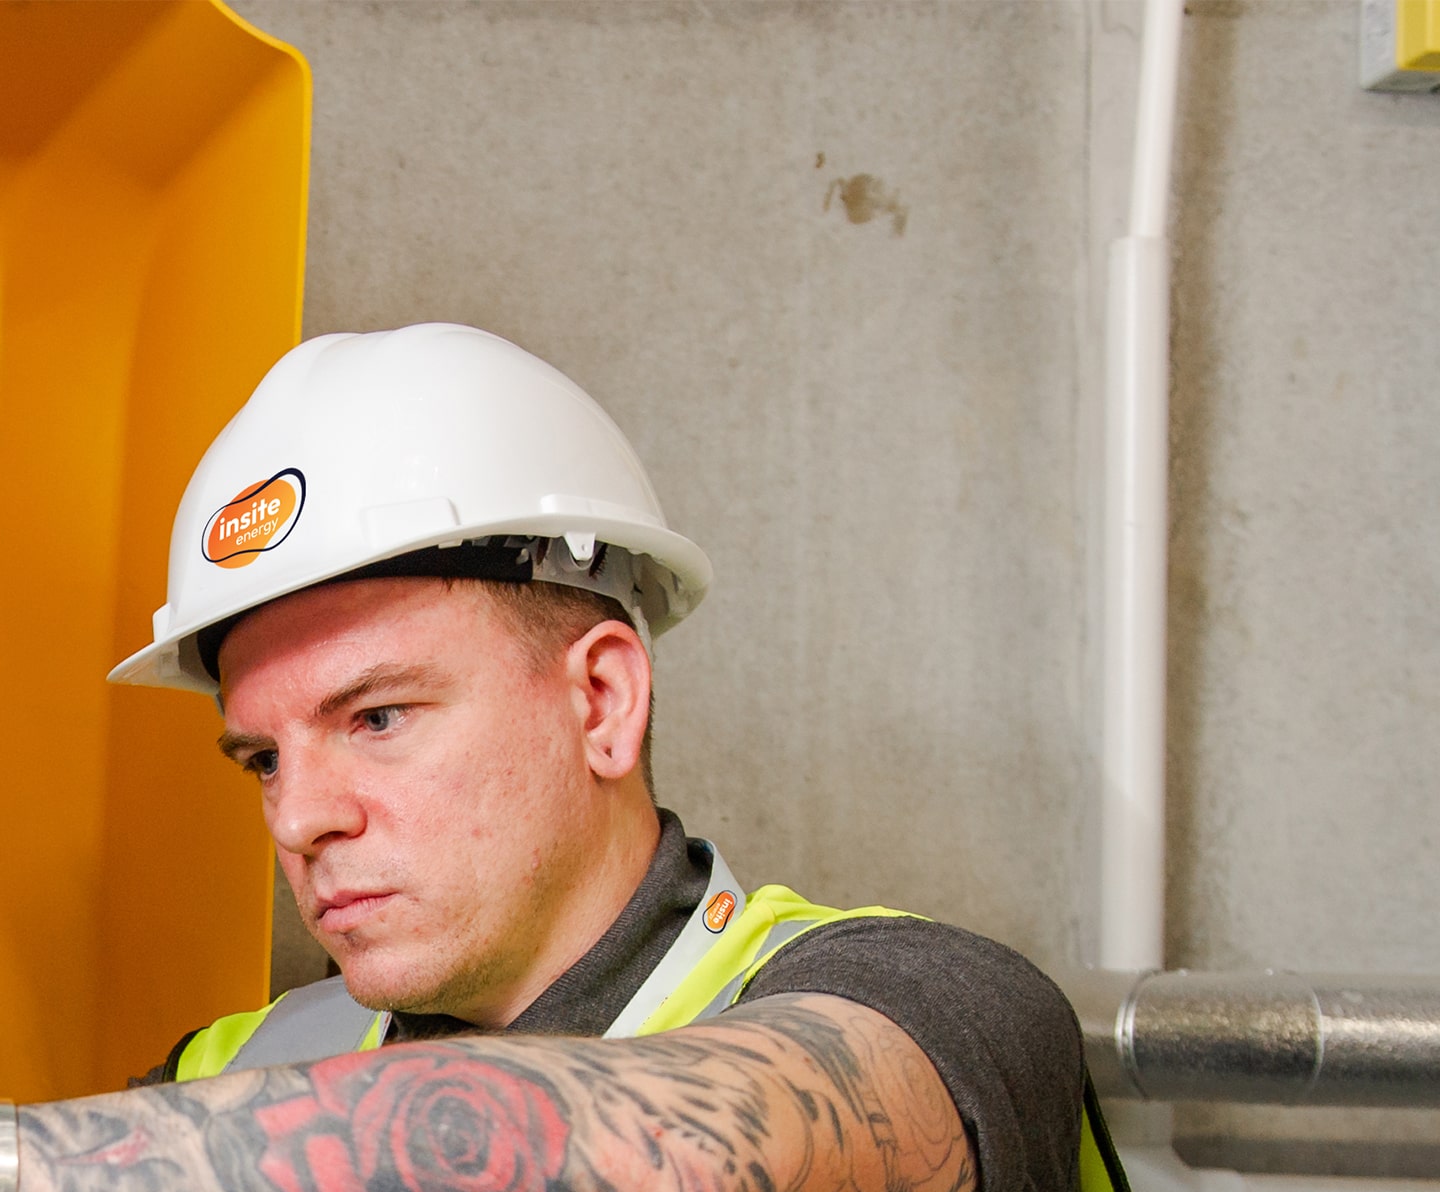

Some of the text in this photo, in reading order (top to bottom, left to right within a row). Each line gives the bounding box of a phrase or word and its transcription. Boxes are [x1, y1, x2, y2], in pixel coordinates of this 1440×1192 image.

[219, 498, 281, 541] insite
[235, 517, 278, 545] energy
[713, 898, 733, 924] insite
